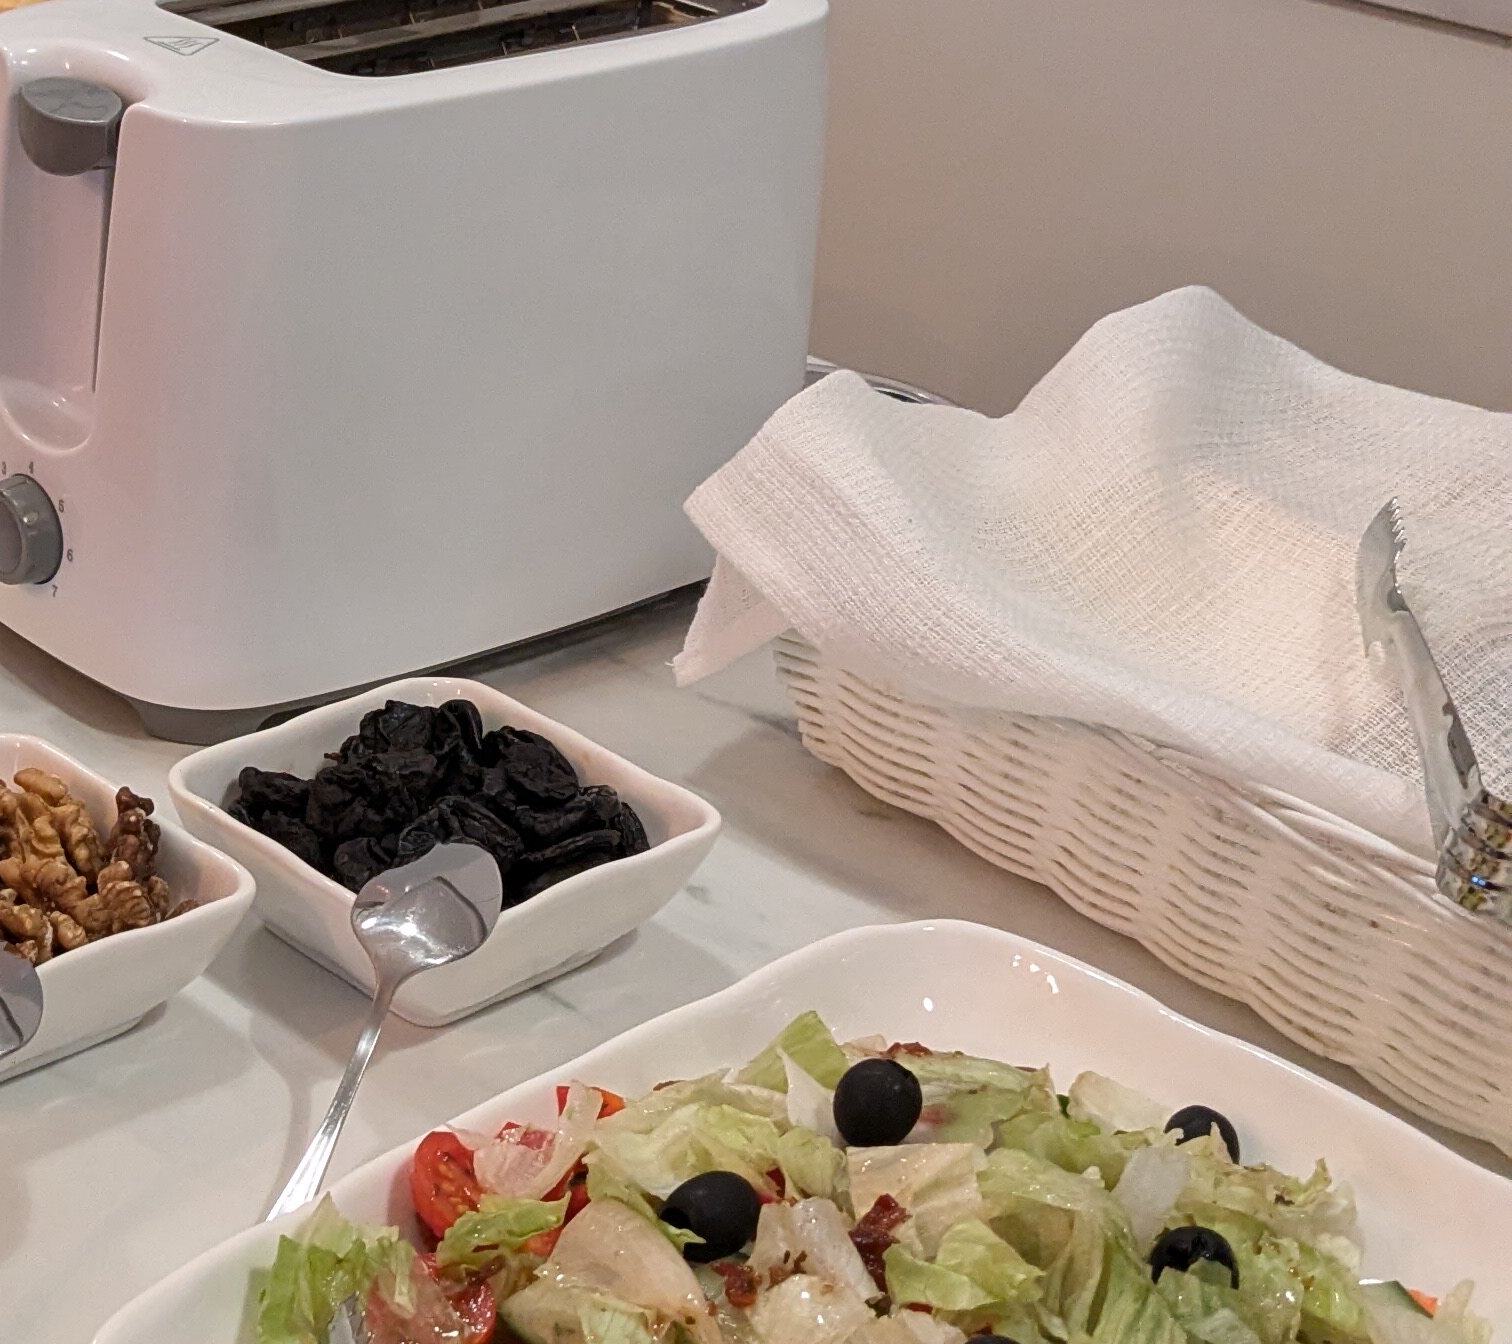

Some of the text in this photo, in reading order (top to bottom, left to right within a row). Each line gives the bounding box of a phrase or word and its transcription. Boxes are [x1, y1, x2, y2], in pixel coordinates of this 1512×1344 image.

[58, 499, 65, 514] 5
[66, 548, 74, 563] 6
[51, 584, 58, 598] 7
